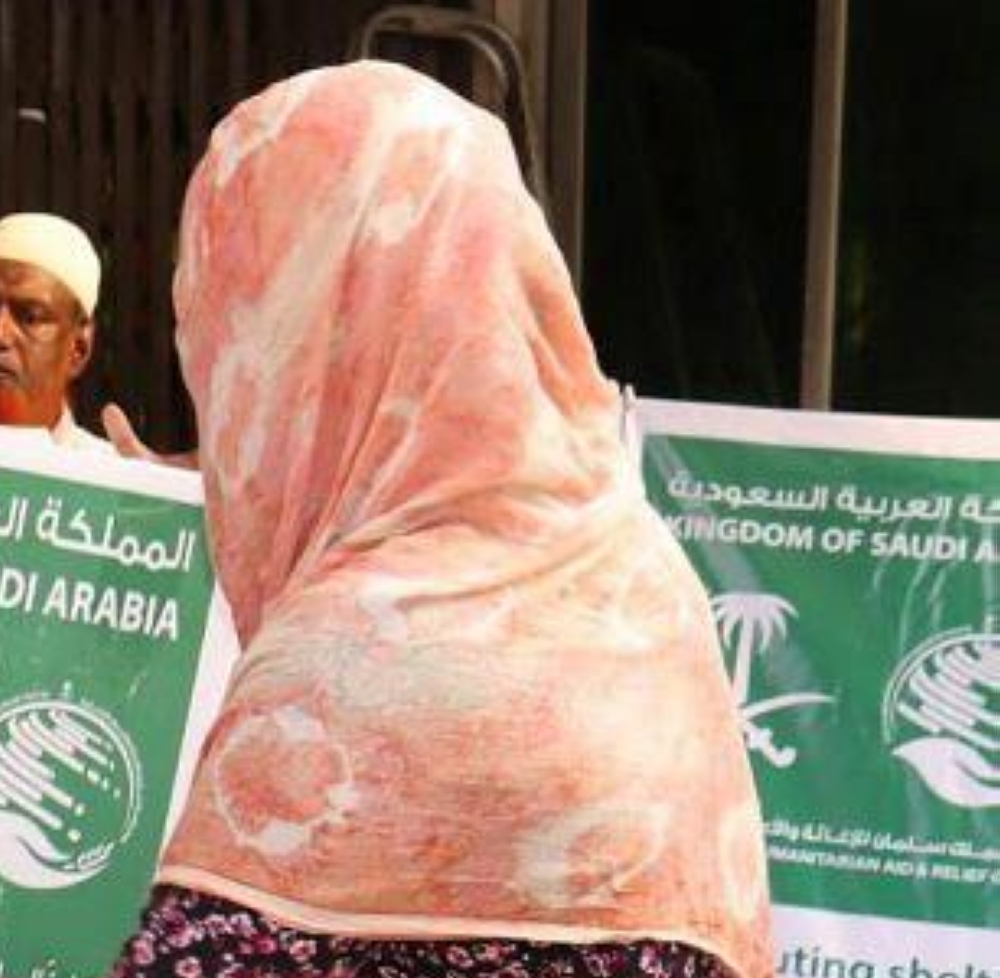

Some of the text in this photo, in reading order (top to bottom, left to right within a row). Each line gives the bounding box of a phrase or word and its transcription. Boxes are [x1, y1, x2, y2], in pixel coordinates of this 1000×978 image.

[667, 470, 829, 514] السعودية
[834, 484, 953, 524] العربية
[35, 497, 196, 573] المملكة
[820, 527, 866, 555] OF
[869, 531, 968, 560] SAUDI
[42, 575, 181, 640] ARABIA
